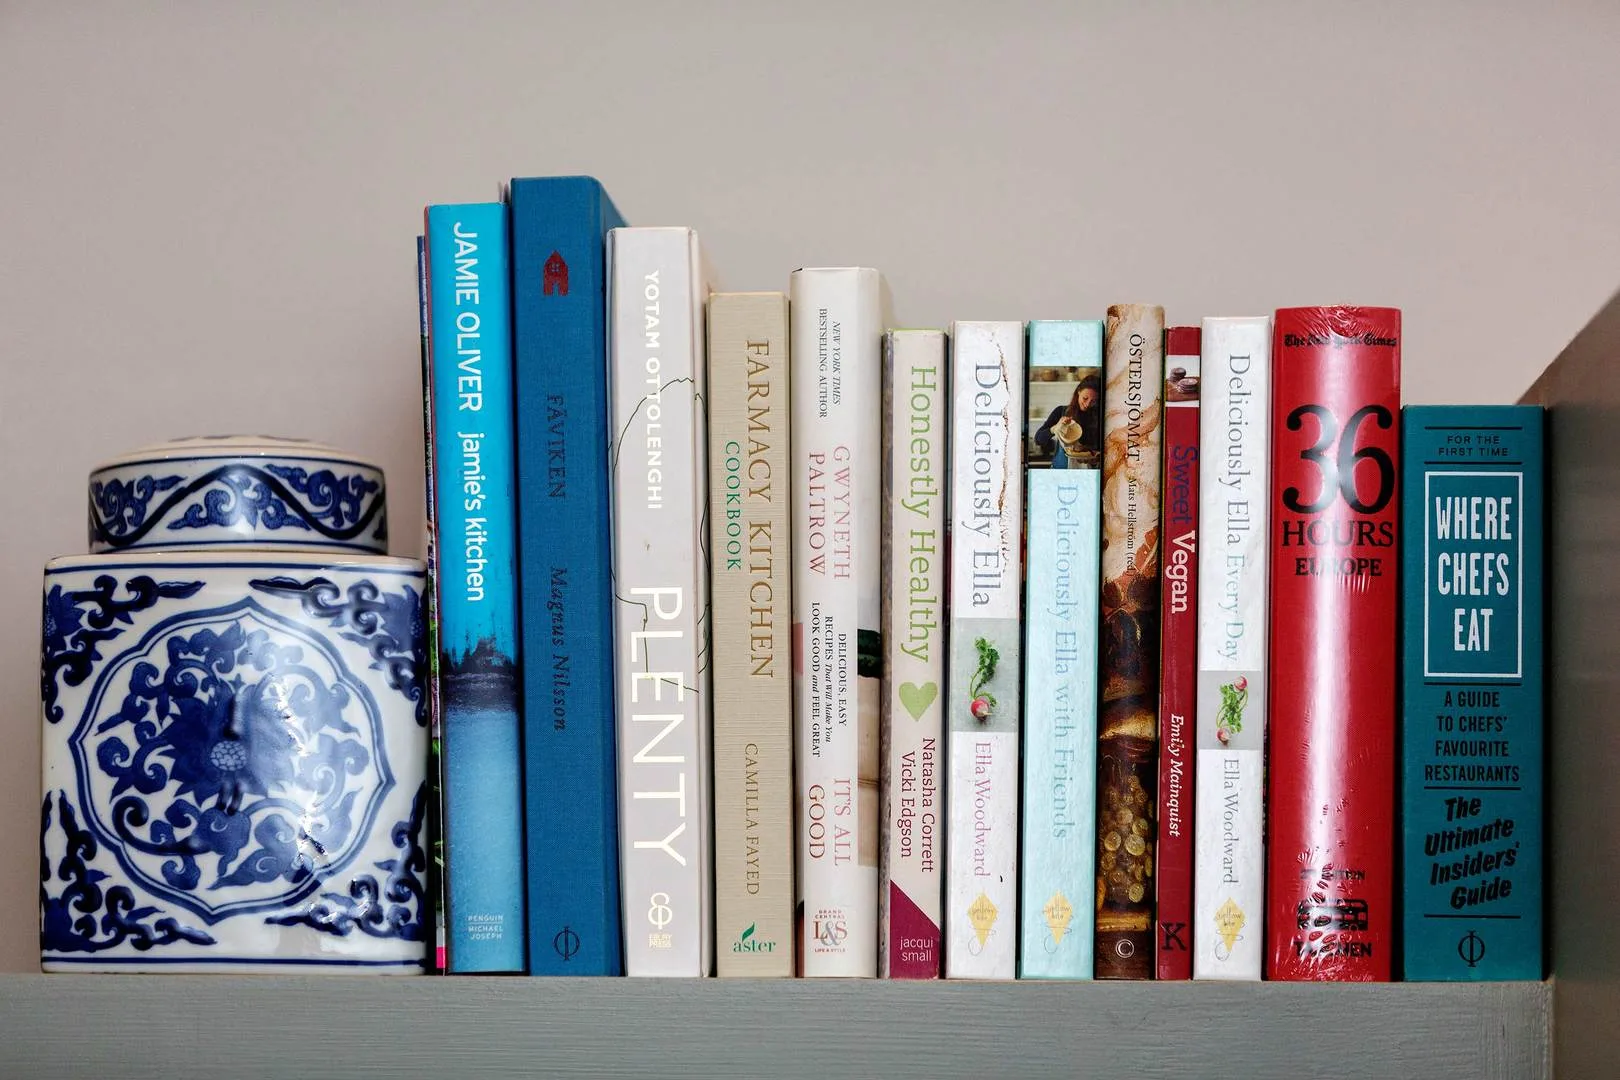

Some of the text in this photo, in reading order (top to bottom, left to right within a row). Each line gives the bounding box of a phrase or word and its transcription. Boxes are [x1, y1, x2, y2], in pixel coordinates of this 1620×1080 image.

[453, 221, 482, 411] JAMIE OLIVER
[819, 308, 828, 418] BESTSELLING AUTHOR
[833, 321, 841, 406] NEW YORK TIMES
[1284, 333, 1306, 347] The
[1363, 332, 1398, 347] Times
[644, 270, 662, 509] YOTAM OTTOLENGHI
[1125, 333, 1146, 461] ÖSTERSJÖMAT
[1447, 435, 1501, 444] FOR THE
[725, 440, 743, 570] COOKBOOK
[962, 362, 1002, 607] Deliciously Ella
[1128, 478, 1138, 500] Mats
[1282, 404, 1395, 514] 36
[1438, 447, 1509, 456] FIRST TIME
[457, 430, 487, 601] jamie's kitchen
[747, 339, 774, 679] FARMACY KITCHEN
[809, 452, 826, 575] PALTROW
[834, 446, 852, 580] GWYNETH
[900, 366, 938, 663] Honestly Healthy
[1127, 503, 1138, 549] Hellström
[1165, 446, 1198, 614] Sweet Vegan
[1218, 355, 1251, 661] Deliciously Ella Every Day
[1282, 520, 1394, 547] HOURS
[1435, 497, 1512, 540] WHERE
[1438, 552, 1510, 596] CHEFS
[546, 566, 571, 731] Magnus Nilsson
[811, 602, 821, 757] LOOK GOOD and FEEL GREAT
[825, 615, 834, 743] RECIPES That Will Make You
[838, 633, 847, 726] DELICIOUS, EASY
[1047, 485, 1079, 839] Deliciously Ella with Friends
[1454, 608, 1493, 652] EAT
[630, 586, 687, 867] PLENTY
[1435, 740, 1509, 757] FAVOURITE
[1436, 716, 1454, 732] TO
[1444, 691, 1500, 707] A GUIDE
[745, 742, 760, 896] CAMILLA FAYED
[808, 784, 825, 860] GOOD
[834, 778, 851, 867] IT'S ALL
[897, 751, 916, 858] Vicki Edgson
[921, 737, 936, 873] Natasha Corrett
[973, 742, 991, 877] Ella Woodward
[1167, 713, 1184, 836] Emily Mainquist
[1222, 758, 1240, 884] Ella Woodward
[1424, 765, 1520, 782] RESTAURANTS
[1444, 797, 1482, 822] The
[1424, 817, 1514, 857] Ultimate
[733, 938, 776, 953] aster
[900, 936, 934, 951] jacqui
[1161, 921, 1187, 951] K
[1450, 878, 1512, 910] Guide
[901, 950, 933, 962] small
